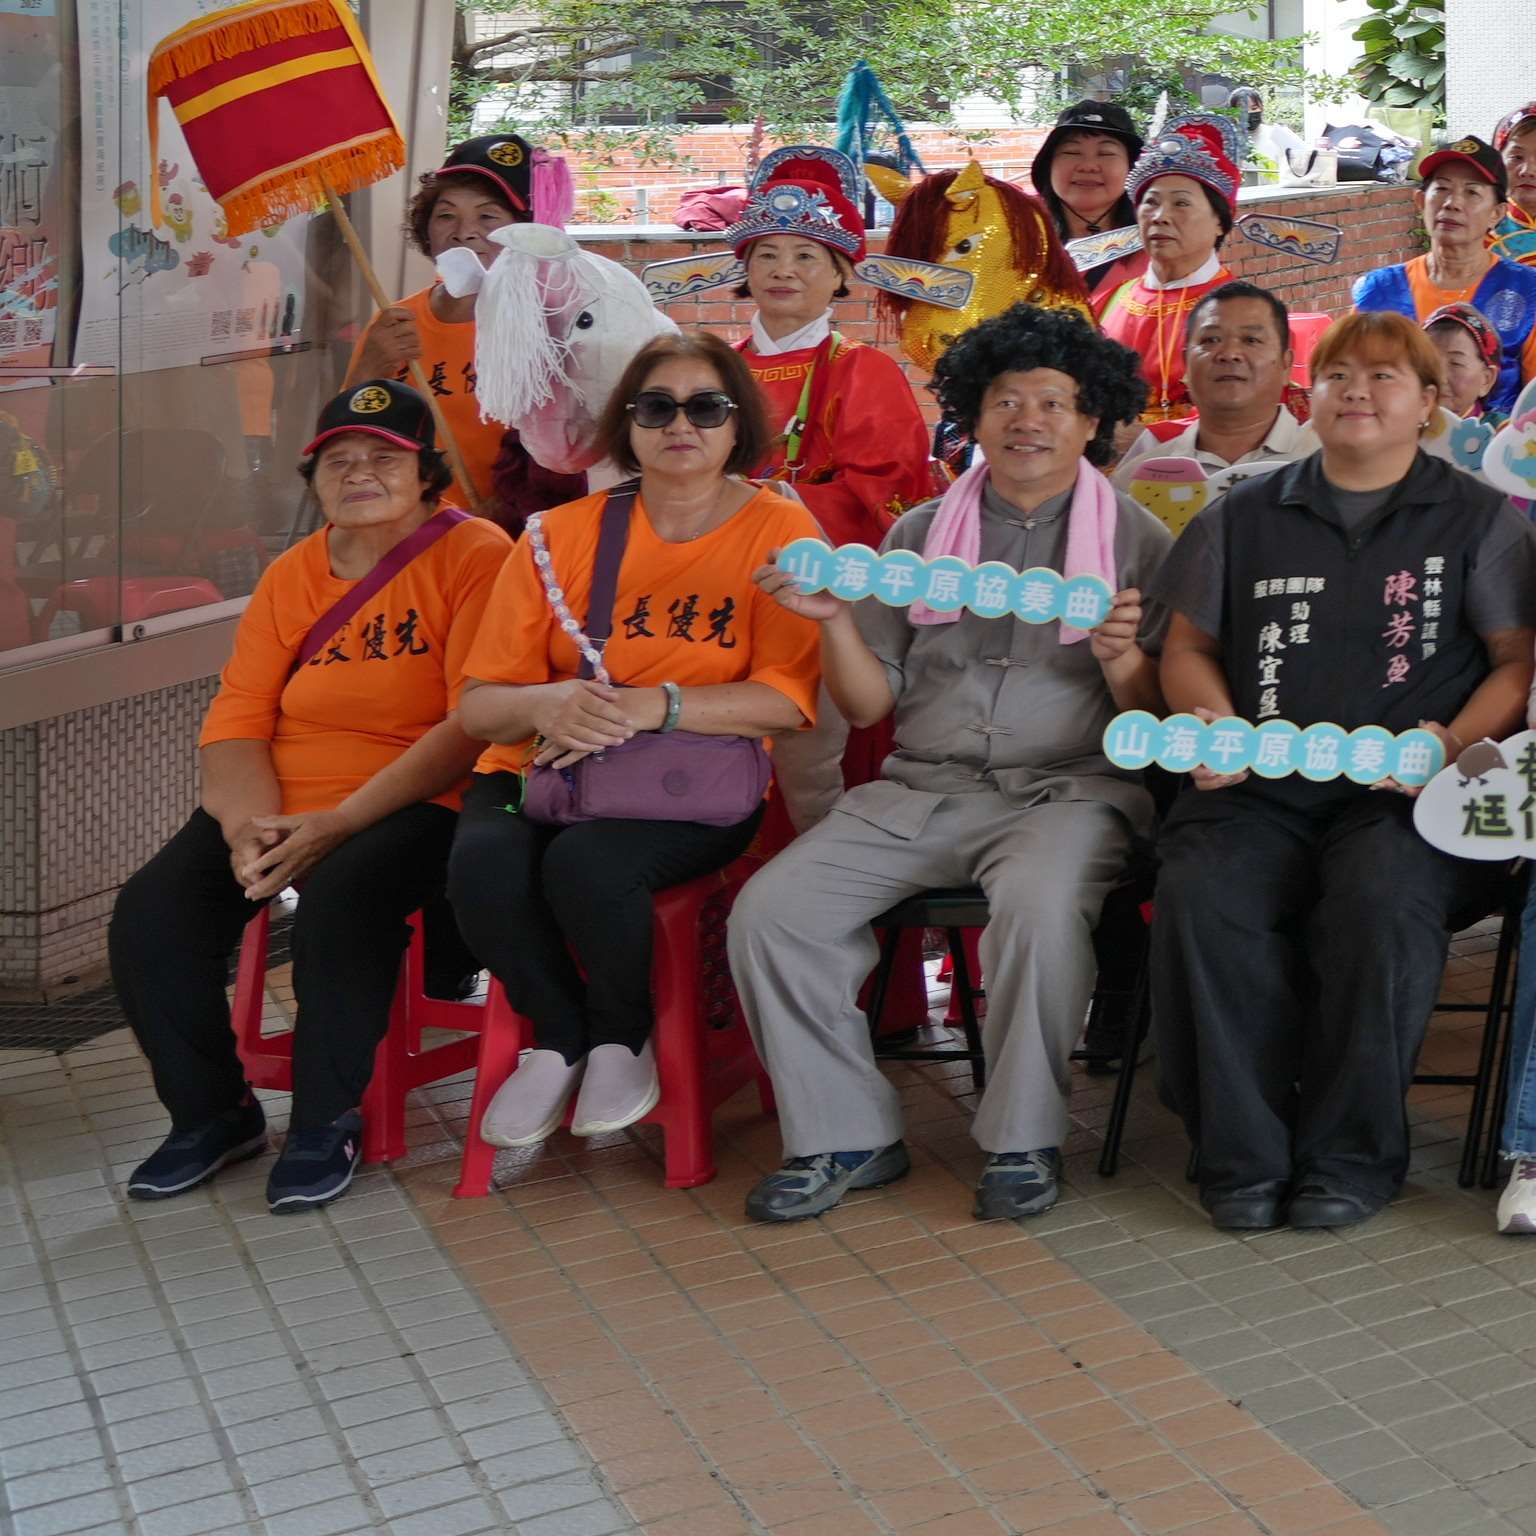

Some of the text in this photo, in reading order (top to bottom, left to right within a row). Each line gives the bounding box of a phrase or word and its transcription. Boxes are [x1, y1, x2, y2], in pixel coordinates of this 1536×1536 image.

[787, 550, 1100, 622] 山海平原協奏曲
[1253, 576, 1327, 599] 服務團隊
[308, 608, 430, 667] 長優先
[582, 593, 737, 650] 長優先
[1289, 601, 1311, 644] 助理
[1114, 722, 1432, 777] 山海平原協奏曲
